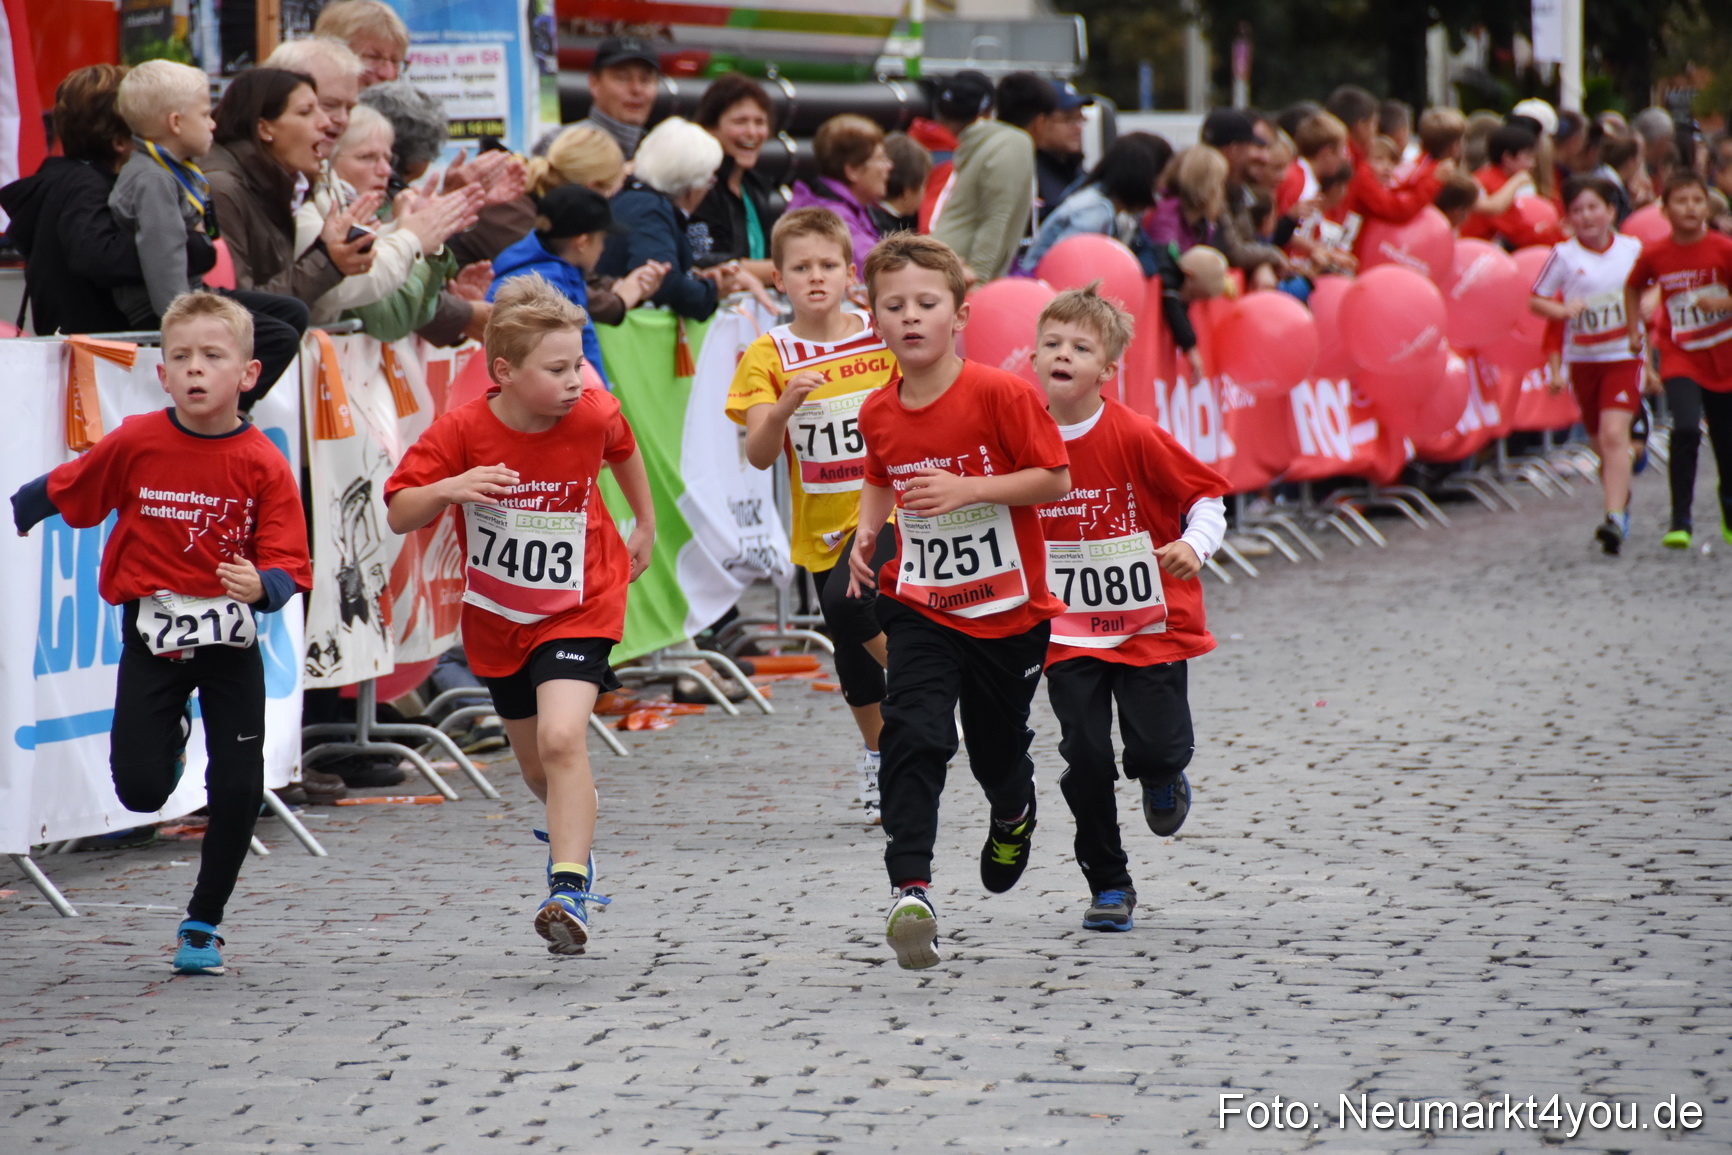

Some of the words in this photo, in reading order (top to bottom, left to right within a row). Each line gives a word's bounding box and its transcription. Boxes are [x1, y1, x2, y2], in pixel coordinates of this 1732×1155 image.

[839, 358, 890, 379] BÖGL
[799, 418, 864, 456] 715
[887, 457, 952, 475] Neumarkter
[139, 487, 220, 507] Neumarkter
[490, 480, 562, 495] markter
[1059, 488, 1102, 502] arkter
[498, 496, 544, 511] dtlauf
[1126, 482, 1138, 536] BAMBIN
[141, 505, 203, 524] Stadtlauf
[474, 511, 508, 527] NeuerMarkt
[516, 514, 576, 530] BOCK
[936, 504, 998, 527] BOCK
[478, 526, 573, 583] 7403
[910, 527, 1003, 580] 7251
[1088, 537, 1146, 557] BOCK
[1055, 561, 1152, 607] 7080
[928, 583, 995, 609] Dominik
[153, 602, 247, 649] 7212
[1091, 616, 1125, 633] Paul
[565, 653, 585, 661] JAKO
